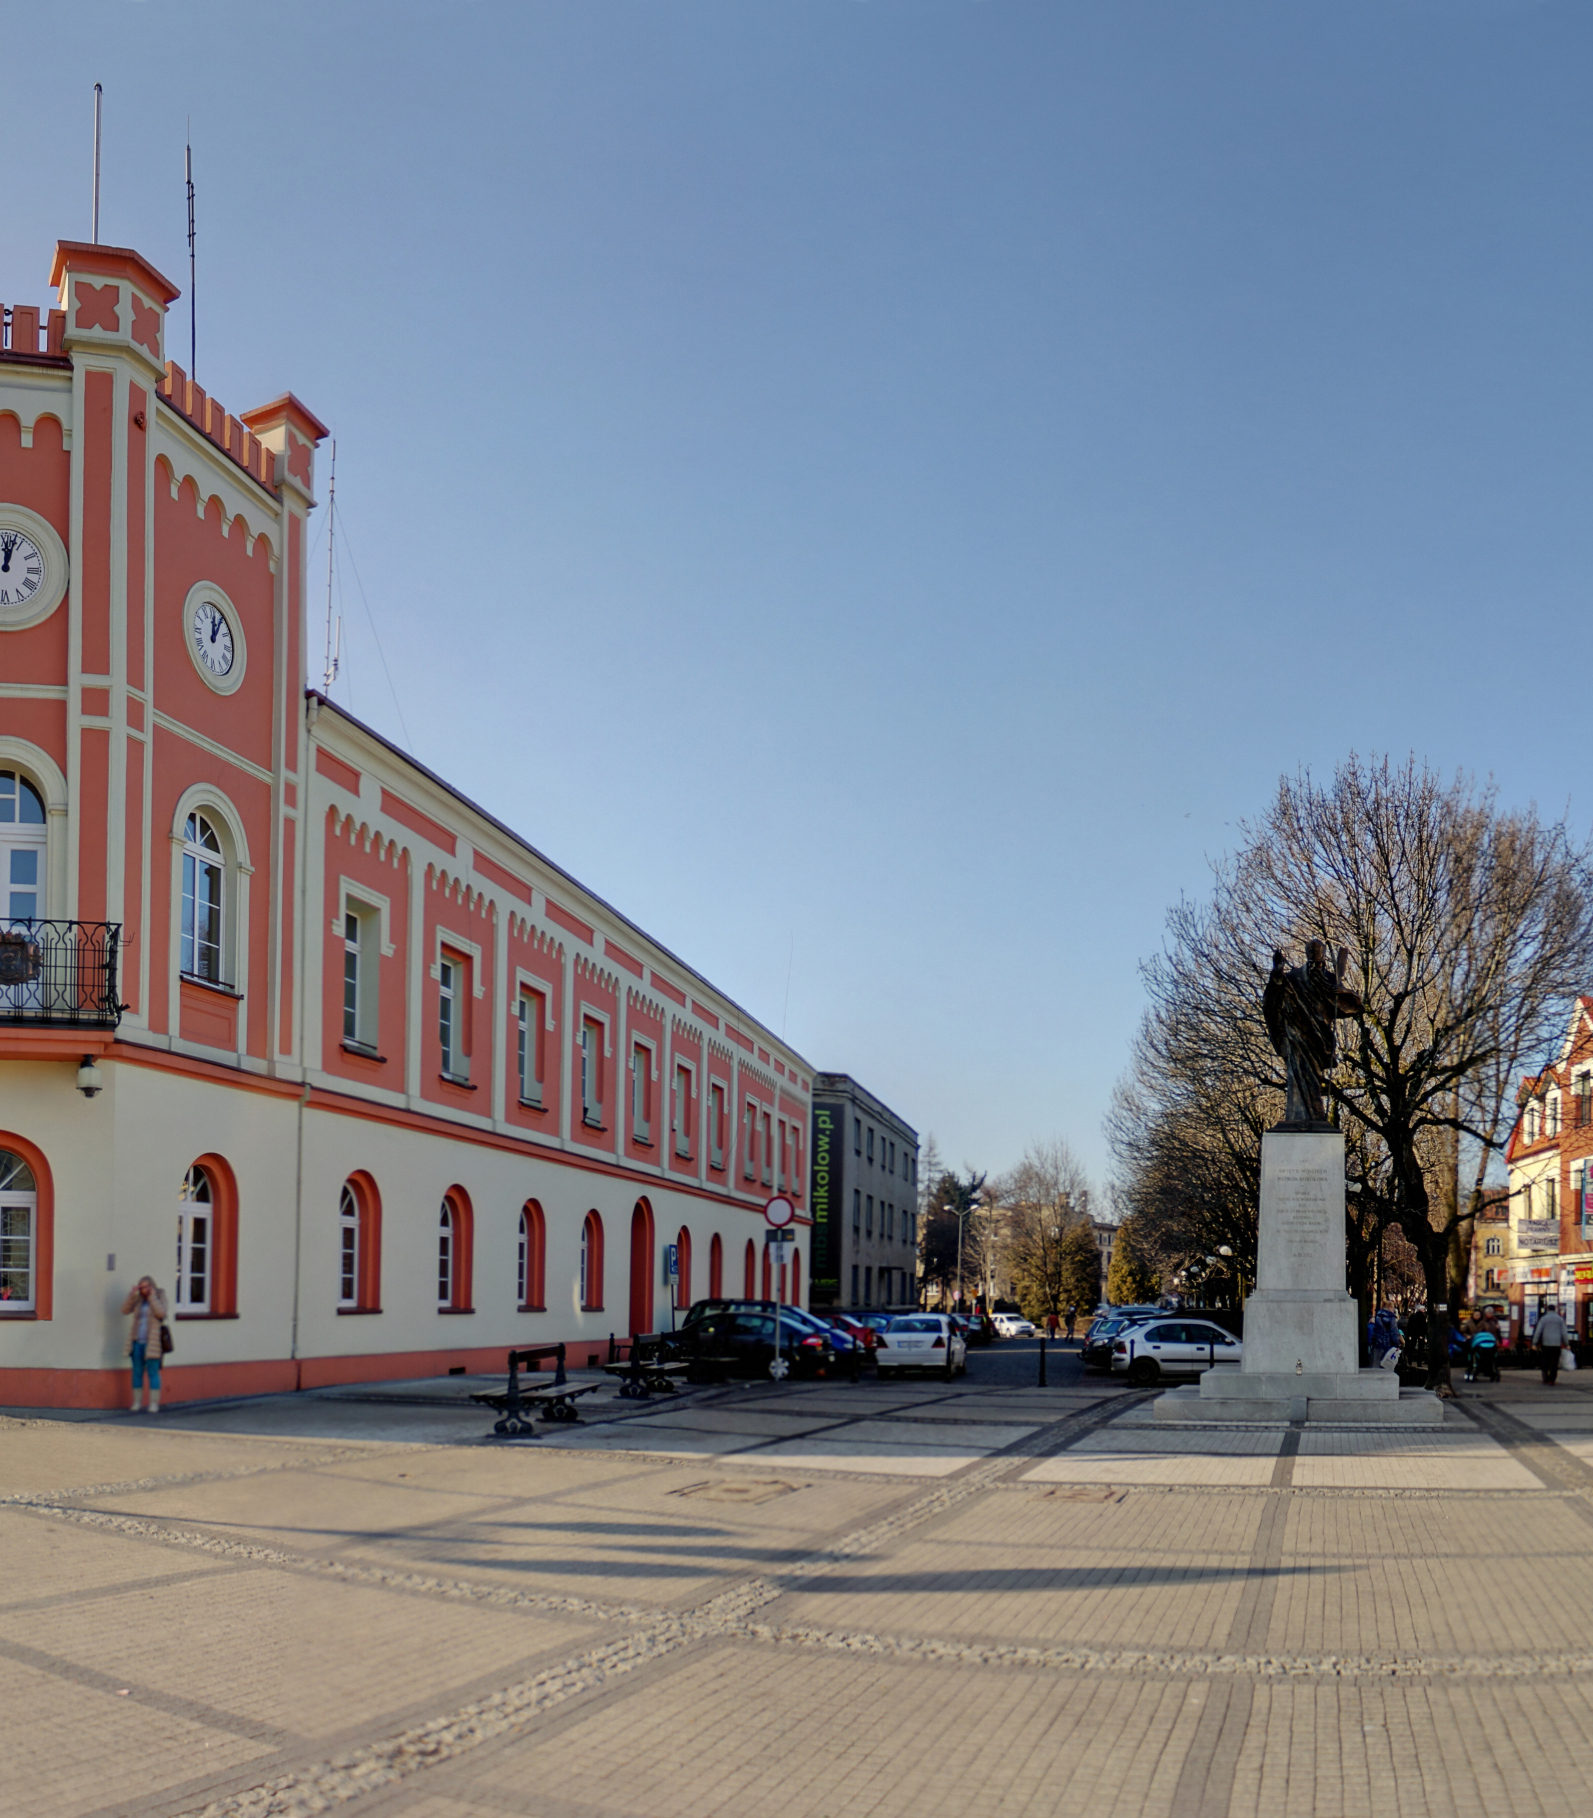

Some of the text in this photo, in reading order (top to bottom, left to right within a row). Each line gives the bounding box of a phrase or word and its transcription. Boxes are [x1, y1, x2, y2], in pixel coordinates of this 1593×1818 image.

[26, 567, 40, 575] III
[0, 589, 10, 603] VI
[15, 588, 25, 601] V
[670, 1247, 677, 1266] P
